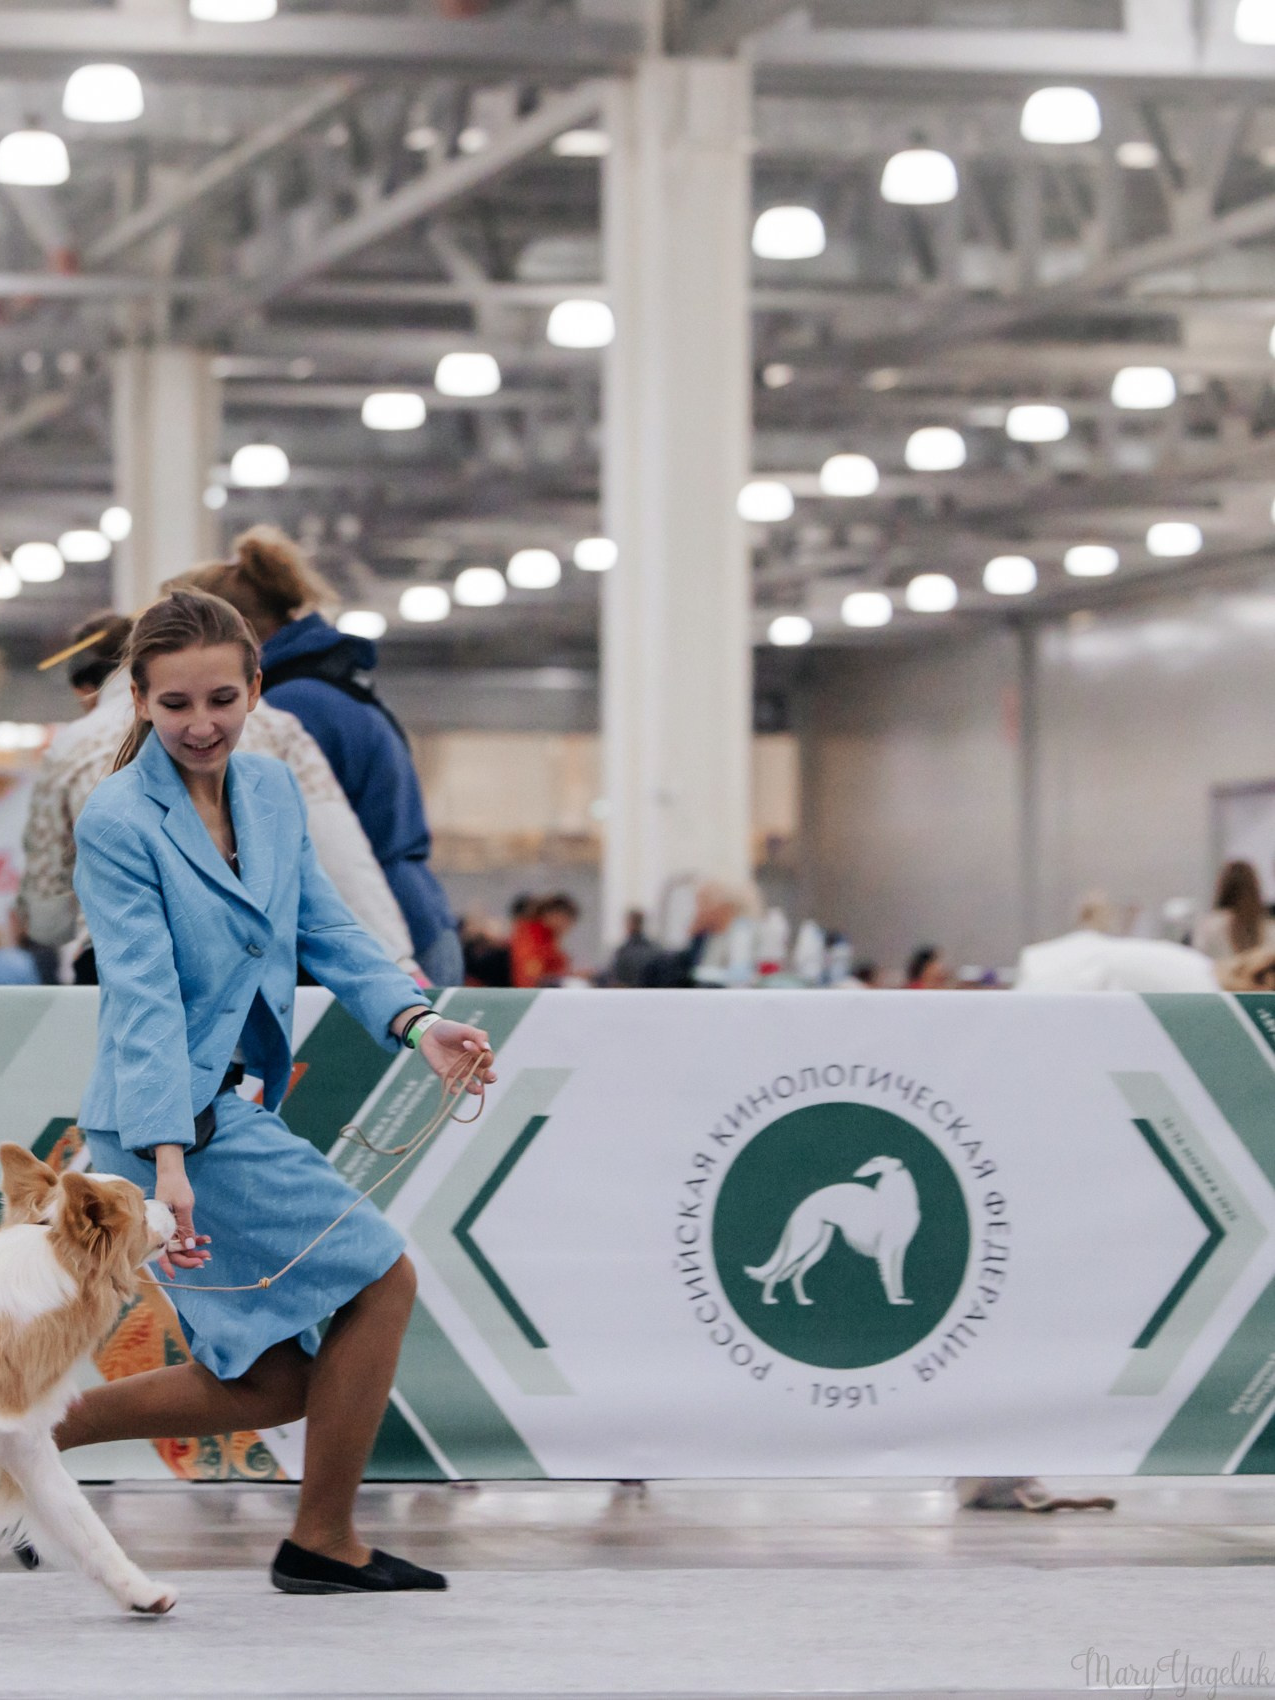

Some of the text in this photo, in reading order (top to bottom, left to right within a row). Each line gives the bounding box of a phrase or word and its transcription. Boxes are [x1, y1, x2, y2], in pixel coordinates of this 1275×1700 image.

[672, 1063, 1010, 1383] РОССИЙСКАЯ КИНОЛОГИЧЕСКАЯ ФЕДЕРАЦИЯ
[809, 1383, 880, 1409] 1991
